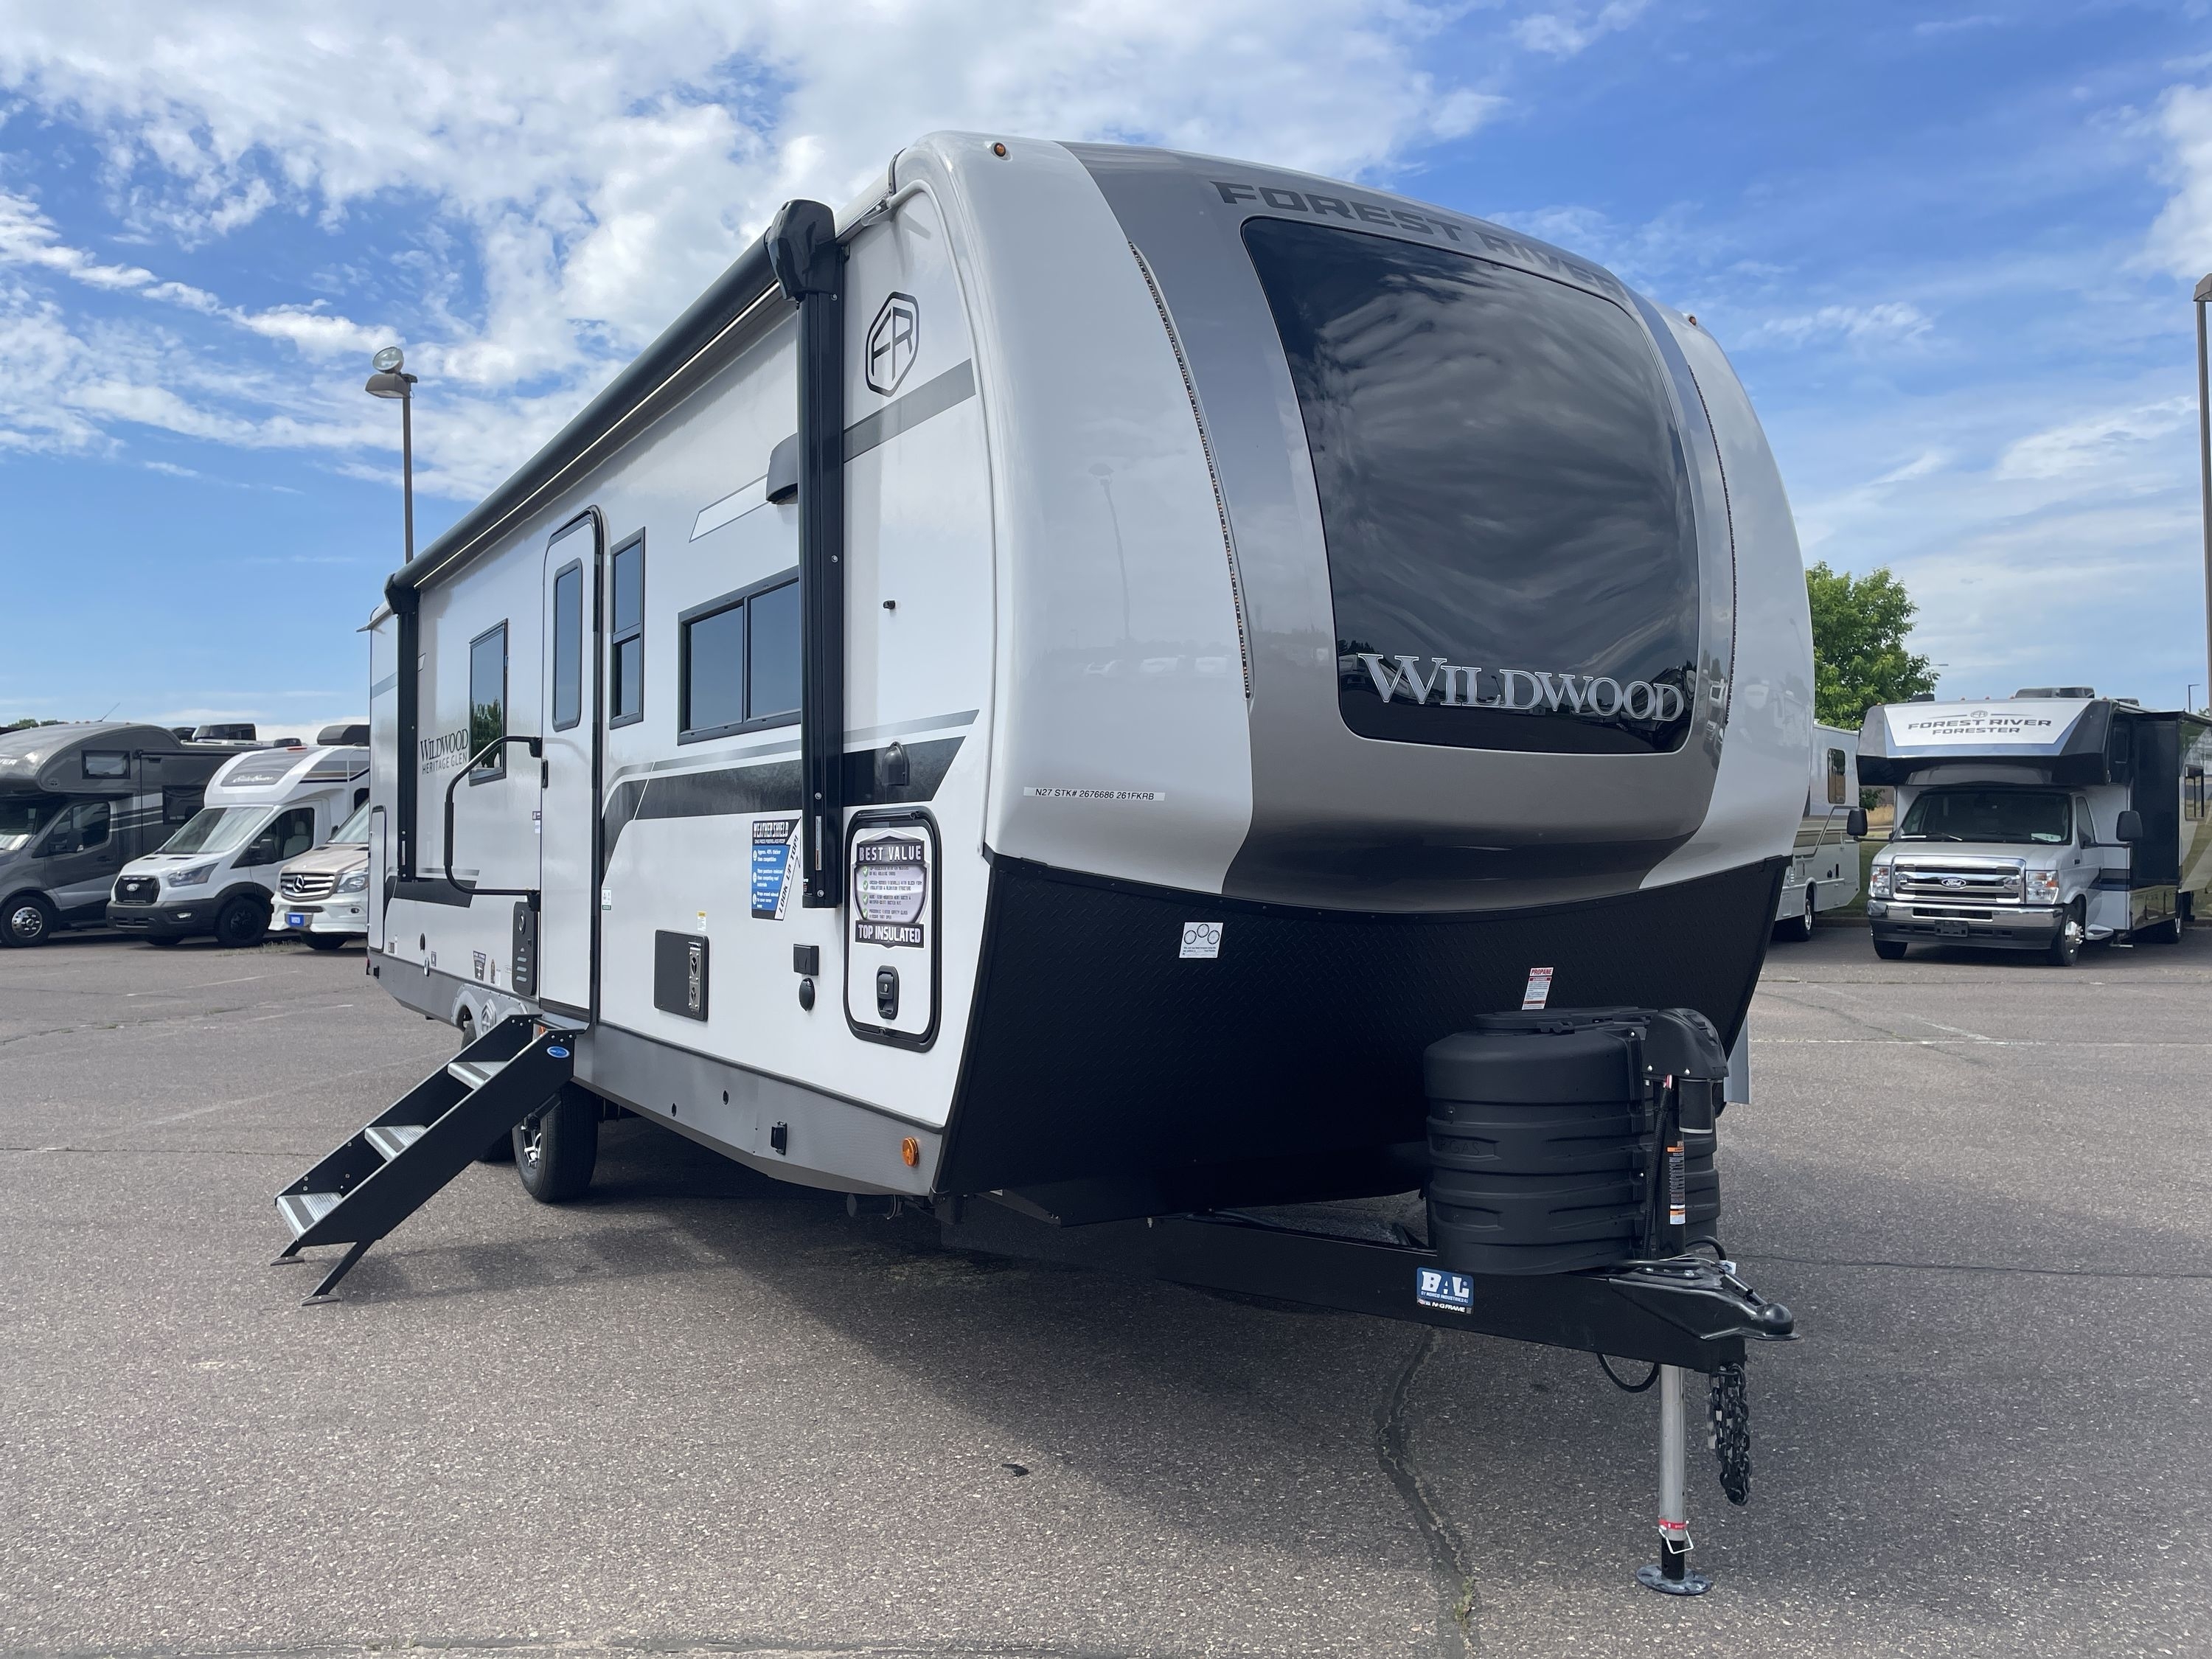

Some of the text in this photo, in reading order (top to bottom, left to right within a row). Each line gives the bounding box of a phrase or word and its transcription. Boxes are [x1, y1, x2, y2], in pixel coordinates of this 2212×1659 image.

[1209, 180, 1628, 300] FOREST RIVER
[1357, 653, 1684, 722] WILDWOOD
[1908, 720, 1985, 729] FOREST
[1933, 727, 2020, 735] FORESTER
[420, 728, 468, 762] WILDWOOD
[422, 751, 467, 775] HERITAGE GLEN
[1054, 789, 1077, 797] STK#
[1079, 790, 1114, 799] 2676686
[1116, 792, 1154, 800] 261FKRB
[859, 845, 921, 861] BEST VALUE
[779, 886, 787, 914] LOOK
[786, 864, 792, 881] UP
[858, 924, 921, 943] TOP INSULATED
[1422, 1271, 1470, 1298] BAL
[1445, 1304, 1465, 1312] FRAME
